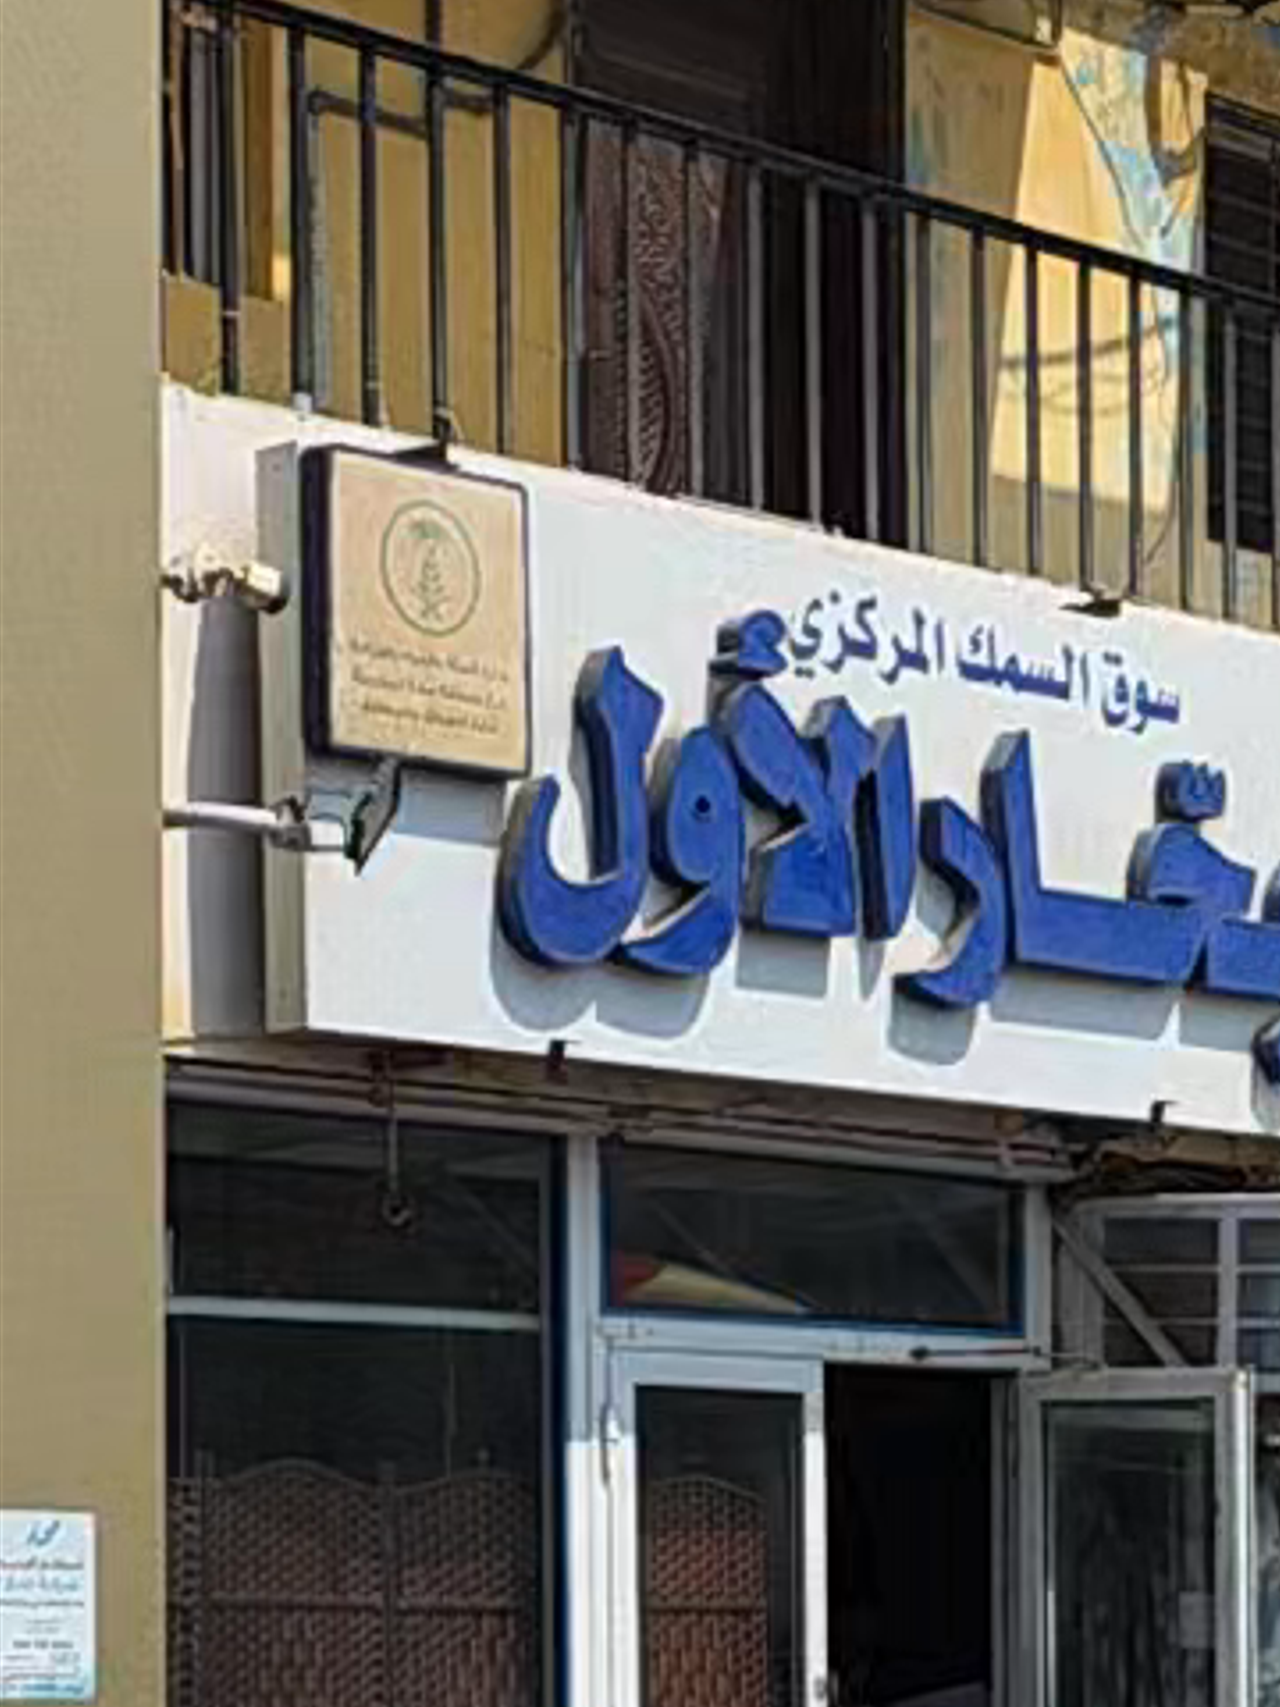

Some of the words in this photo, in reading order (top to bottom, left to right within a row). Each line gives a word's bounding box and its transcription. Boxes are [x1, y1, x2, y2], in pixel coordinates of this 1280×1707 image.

[789, 590, 944, 684] المركزي
[957, 624, 1089, 705] السمك
[1101, 649, 1180, 734] سوق
[495, 608, 913, 974] الأول
